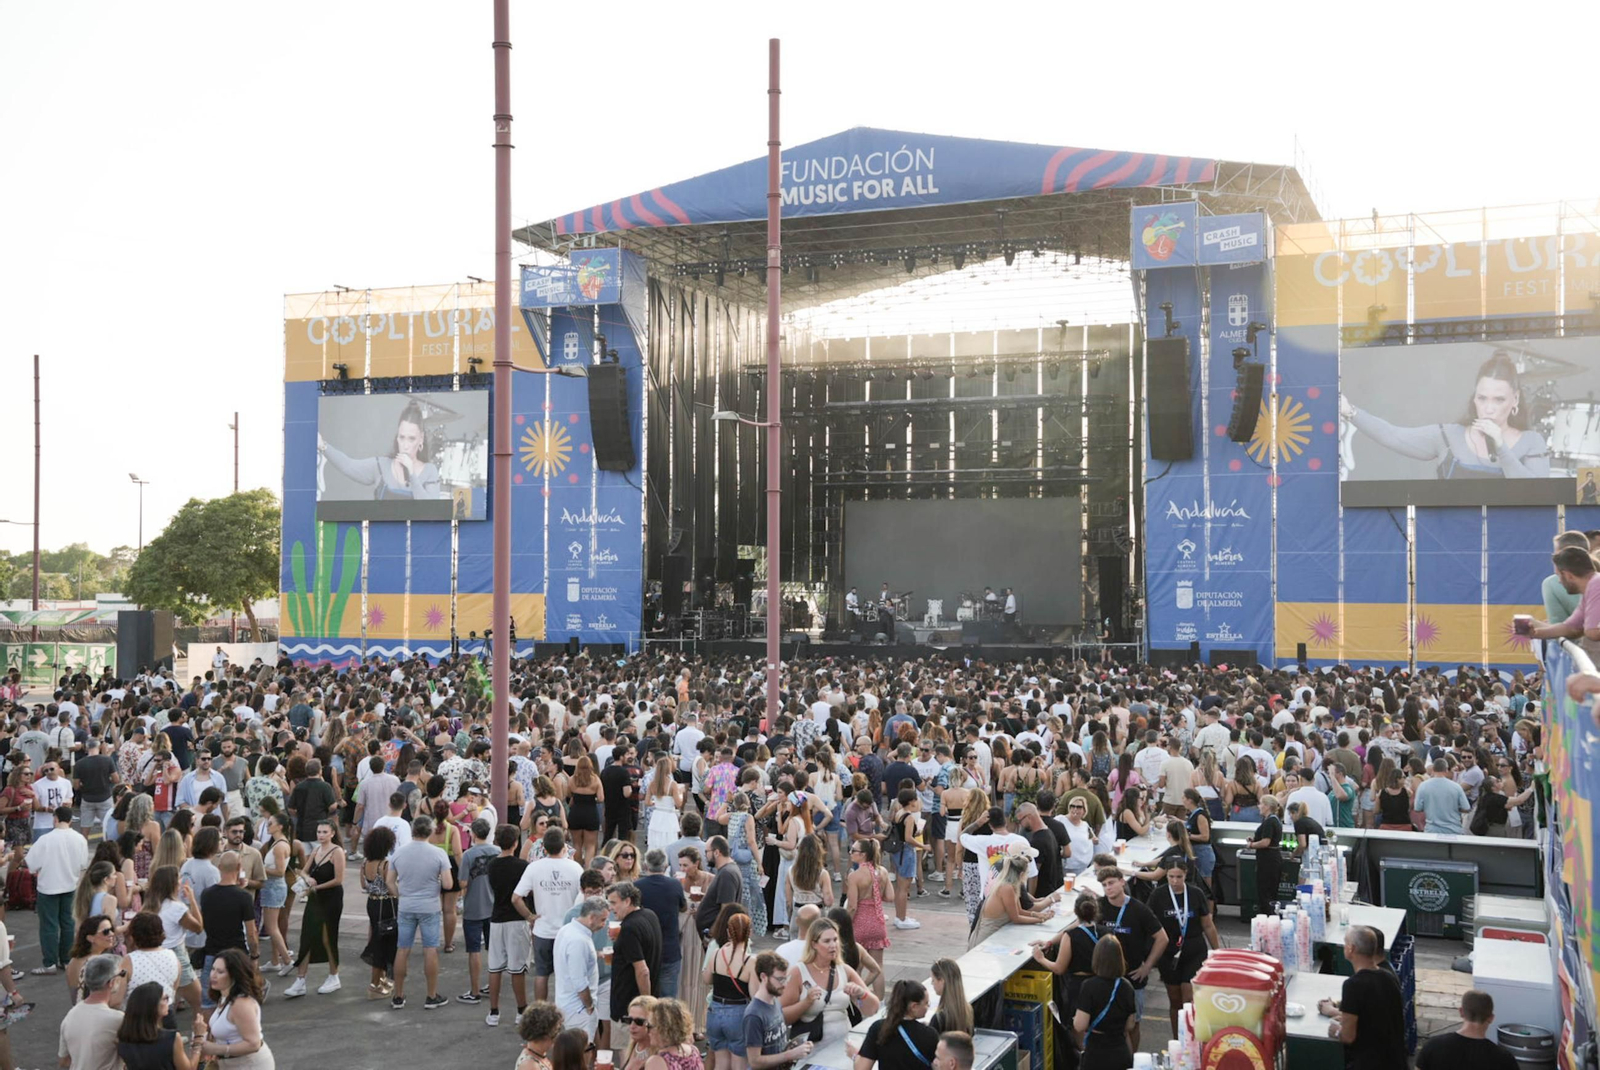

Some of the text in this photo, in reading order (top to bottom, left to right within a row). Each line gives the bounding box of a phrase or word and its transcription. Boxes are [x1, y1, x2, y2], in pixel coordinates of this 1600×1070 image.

[780, 145, 934, 183] FUNDACIÓN
[780, 173, 939, 207] MUSIC FOR ALL
[1205, 228, 1238, 242] CRASH
[1223, 237, 1253, 249] MUSIC
[1313, 232, 1600, 287] COOLTUR
[527, 277, 550, 289] CRASH
[1503, 279, 1549, 297] FEST
[539, 285, 562, 296] MUSIC
[306, 307, 520, 346] COOLTURA
[422, 342, 450, 356] FEST
[560, 507, 625, 525] Andalucía
[1166, 499, 1251, 520] Andalucía
[1196, 591, 1243, 599] DIPUTACIÓN
[1209, 599, 1243, 607] ALMERÍA
[540, 880, 572, 888] GUINNESS
[1409, 888, 1449, 897] ESTRELLA
